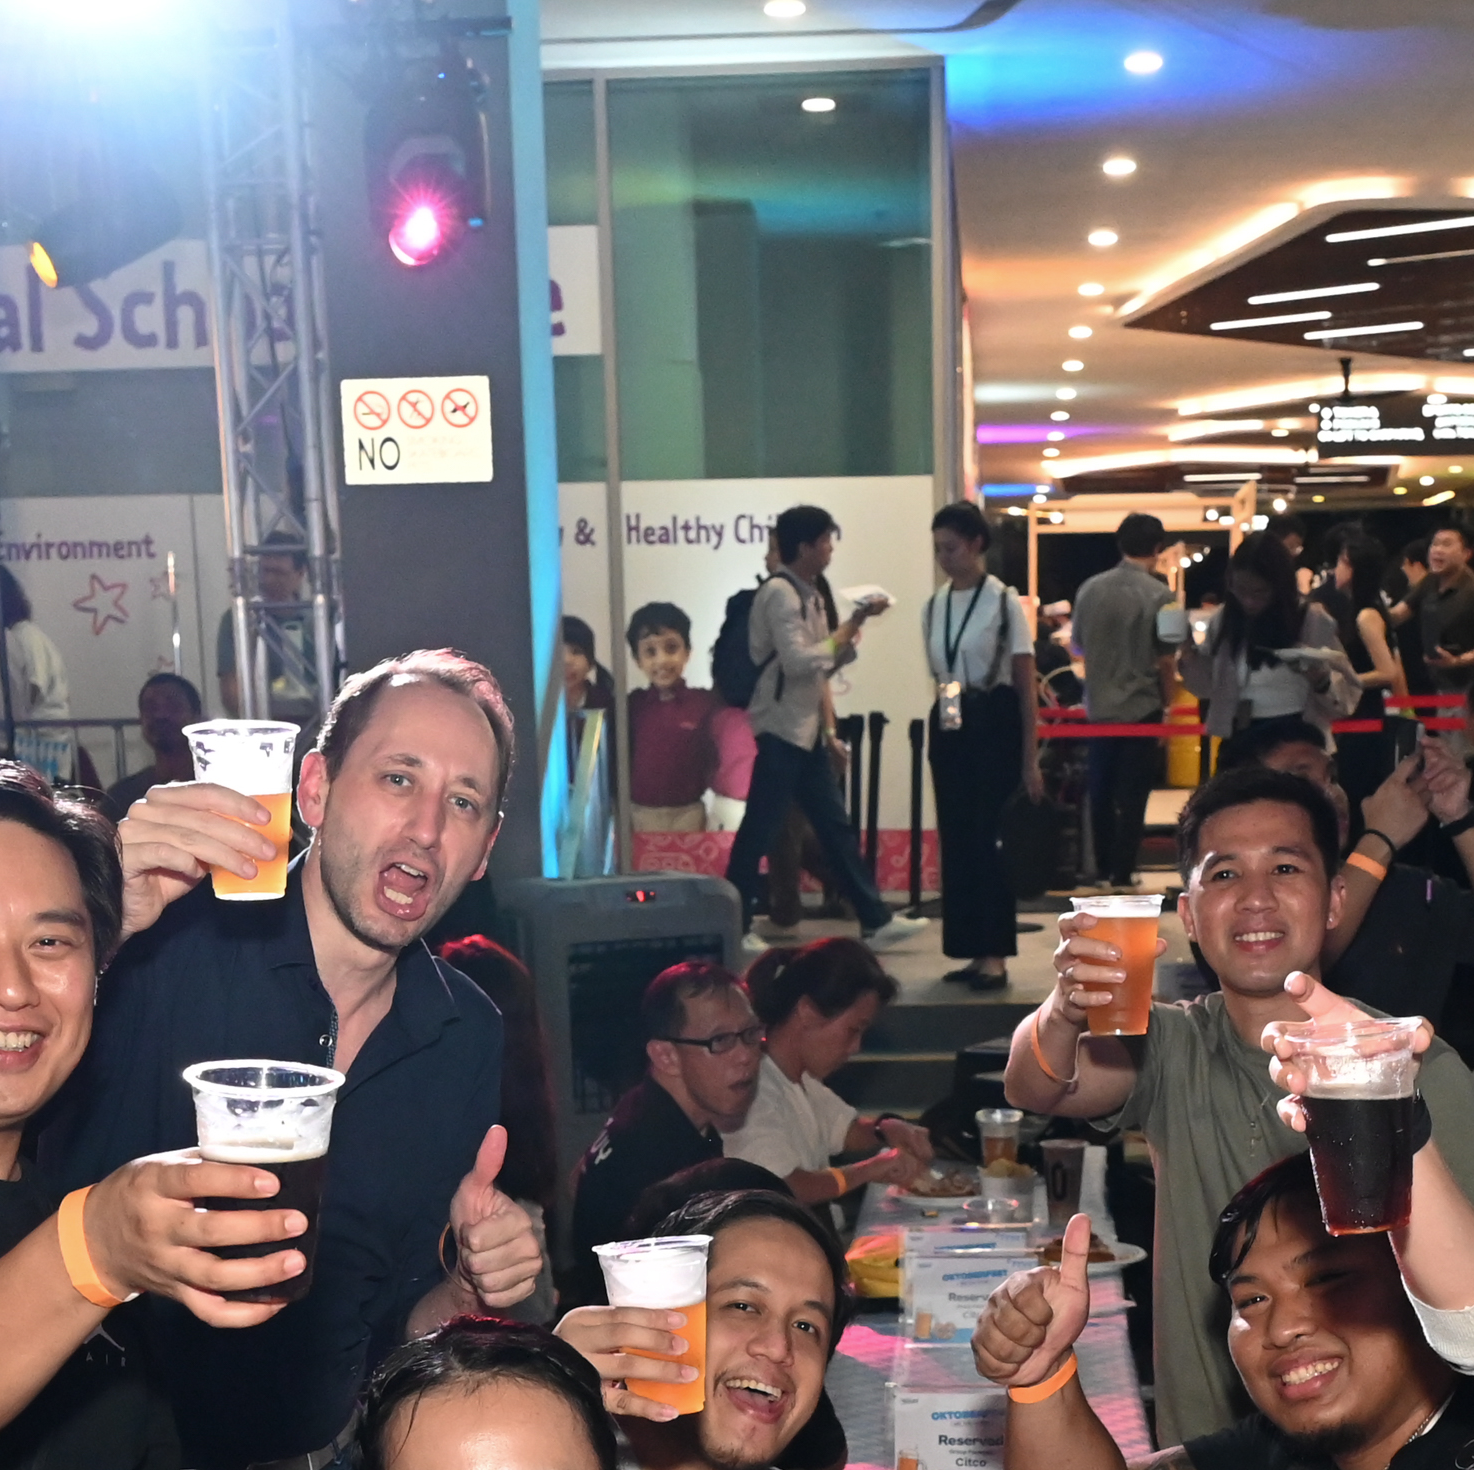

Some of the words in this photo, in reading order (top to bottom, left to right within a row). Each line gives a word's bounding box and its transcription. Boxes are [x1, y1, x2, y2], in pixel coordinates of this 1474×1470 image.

[357, 436, 401, 471] NO
[574, 517, 596, 546] &
[626, 512, 724, 550] Healthy
[938, 1434, 1005, 1447] Reserved
[955, 1457, 987, 1468] Citco
